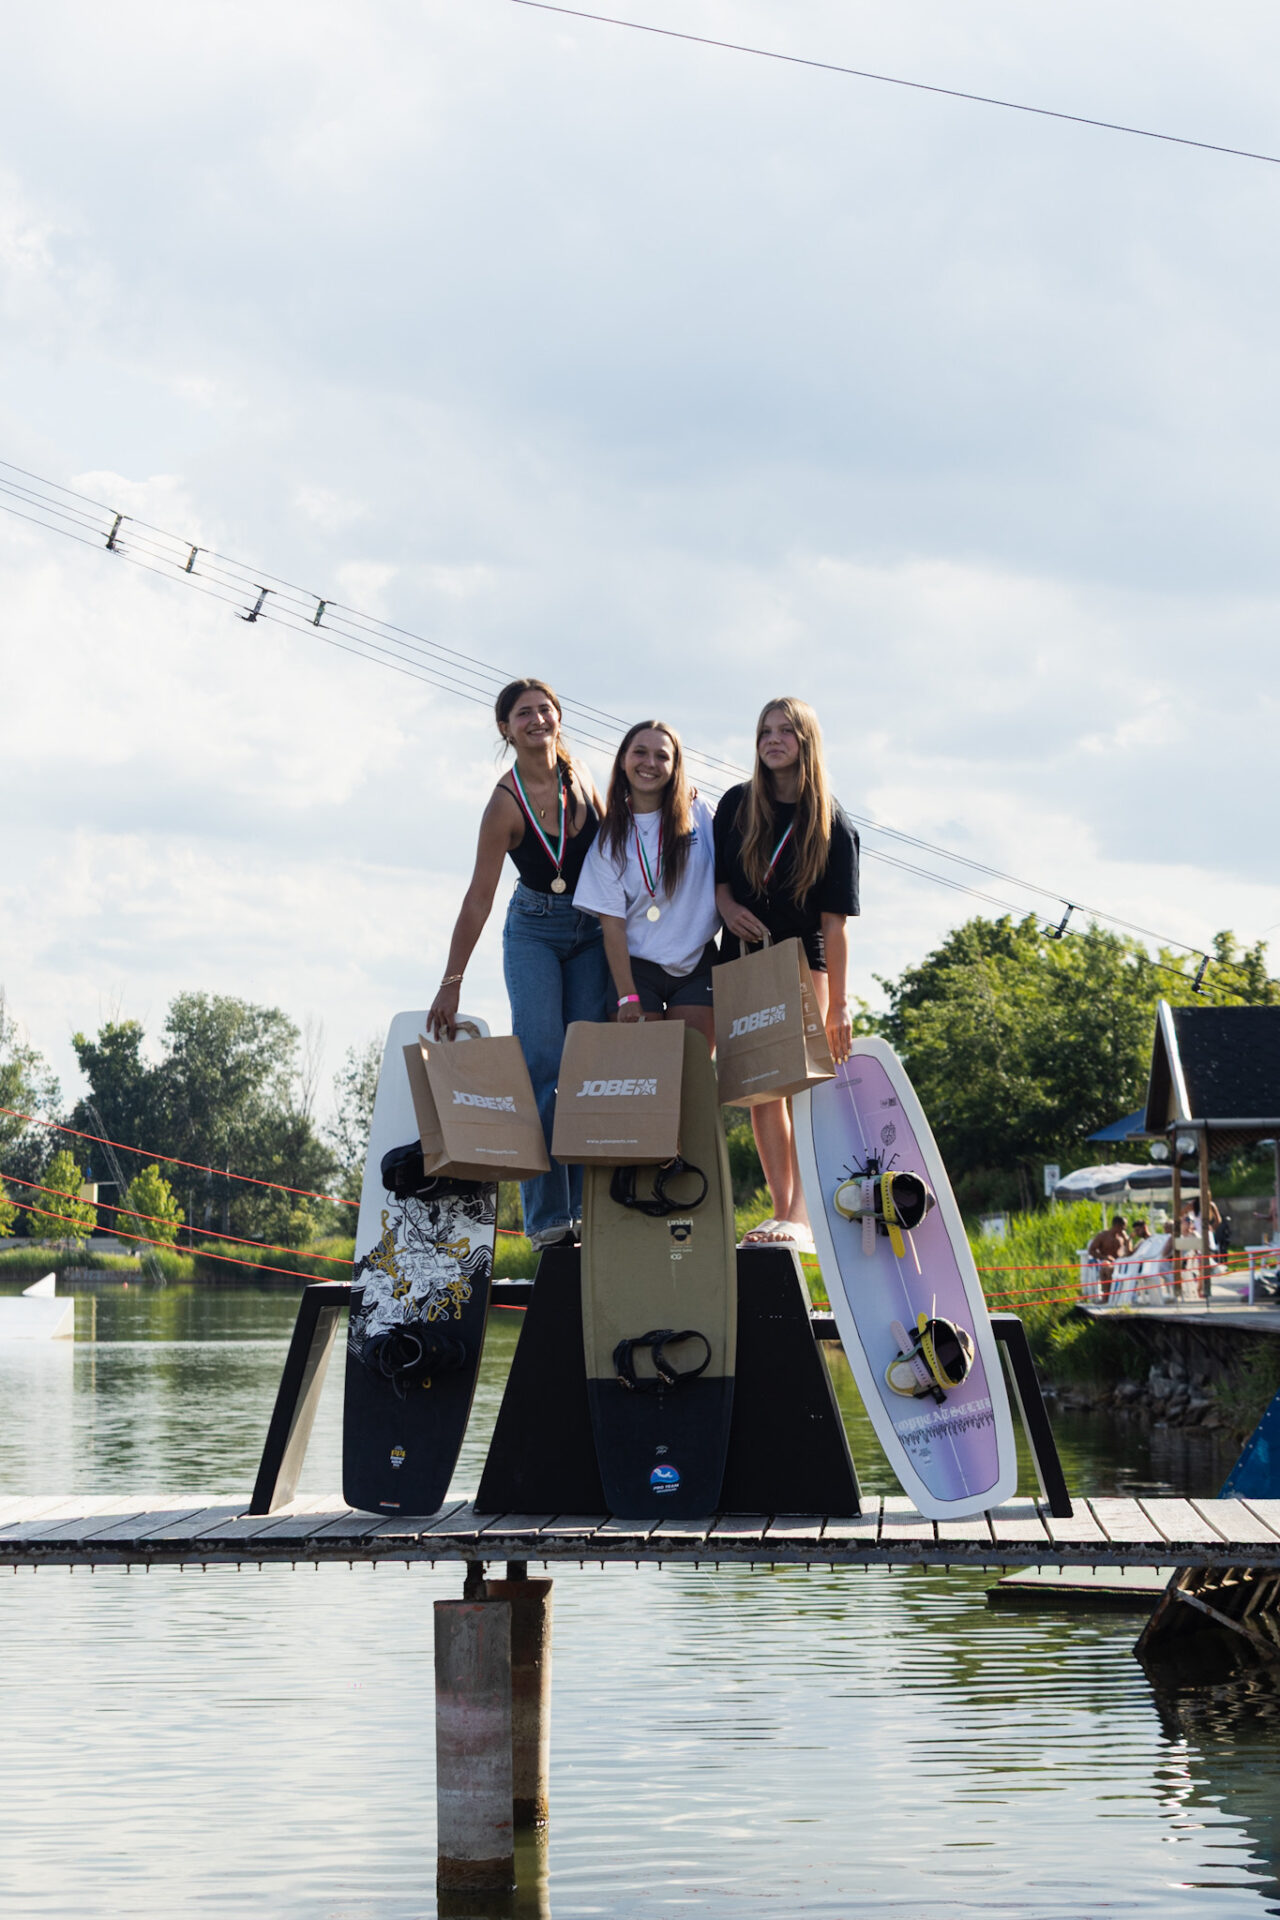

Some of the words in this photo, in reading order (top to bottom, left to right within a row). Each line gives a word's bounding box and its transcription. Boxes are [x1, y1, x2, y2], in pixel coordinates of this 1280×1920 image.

[728, 1008, 771, 1039] JOBE
[576, 1079, 637, 1097] JOBE
[452, 1089, 498, 1110] JOBE
